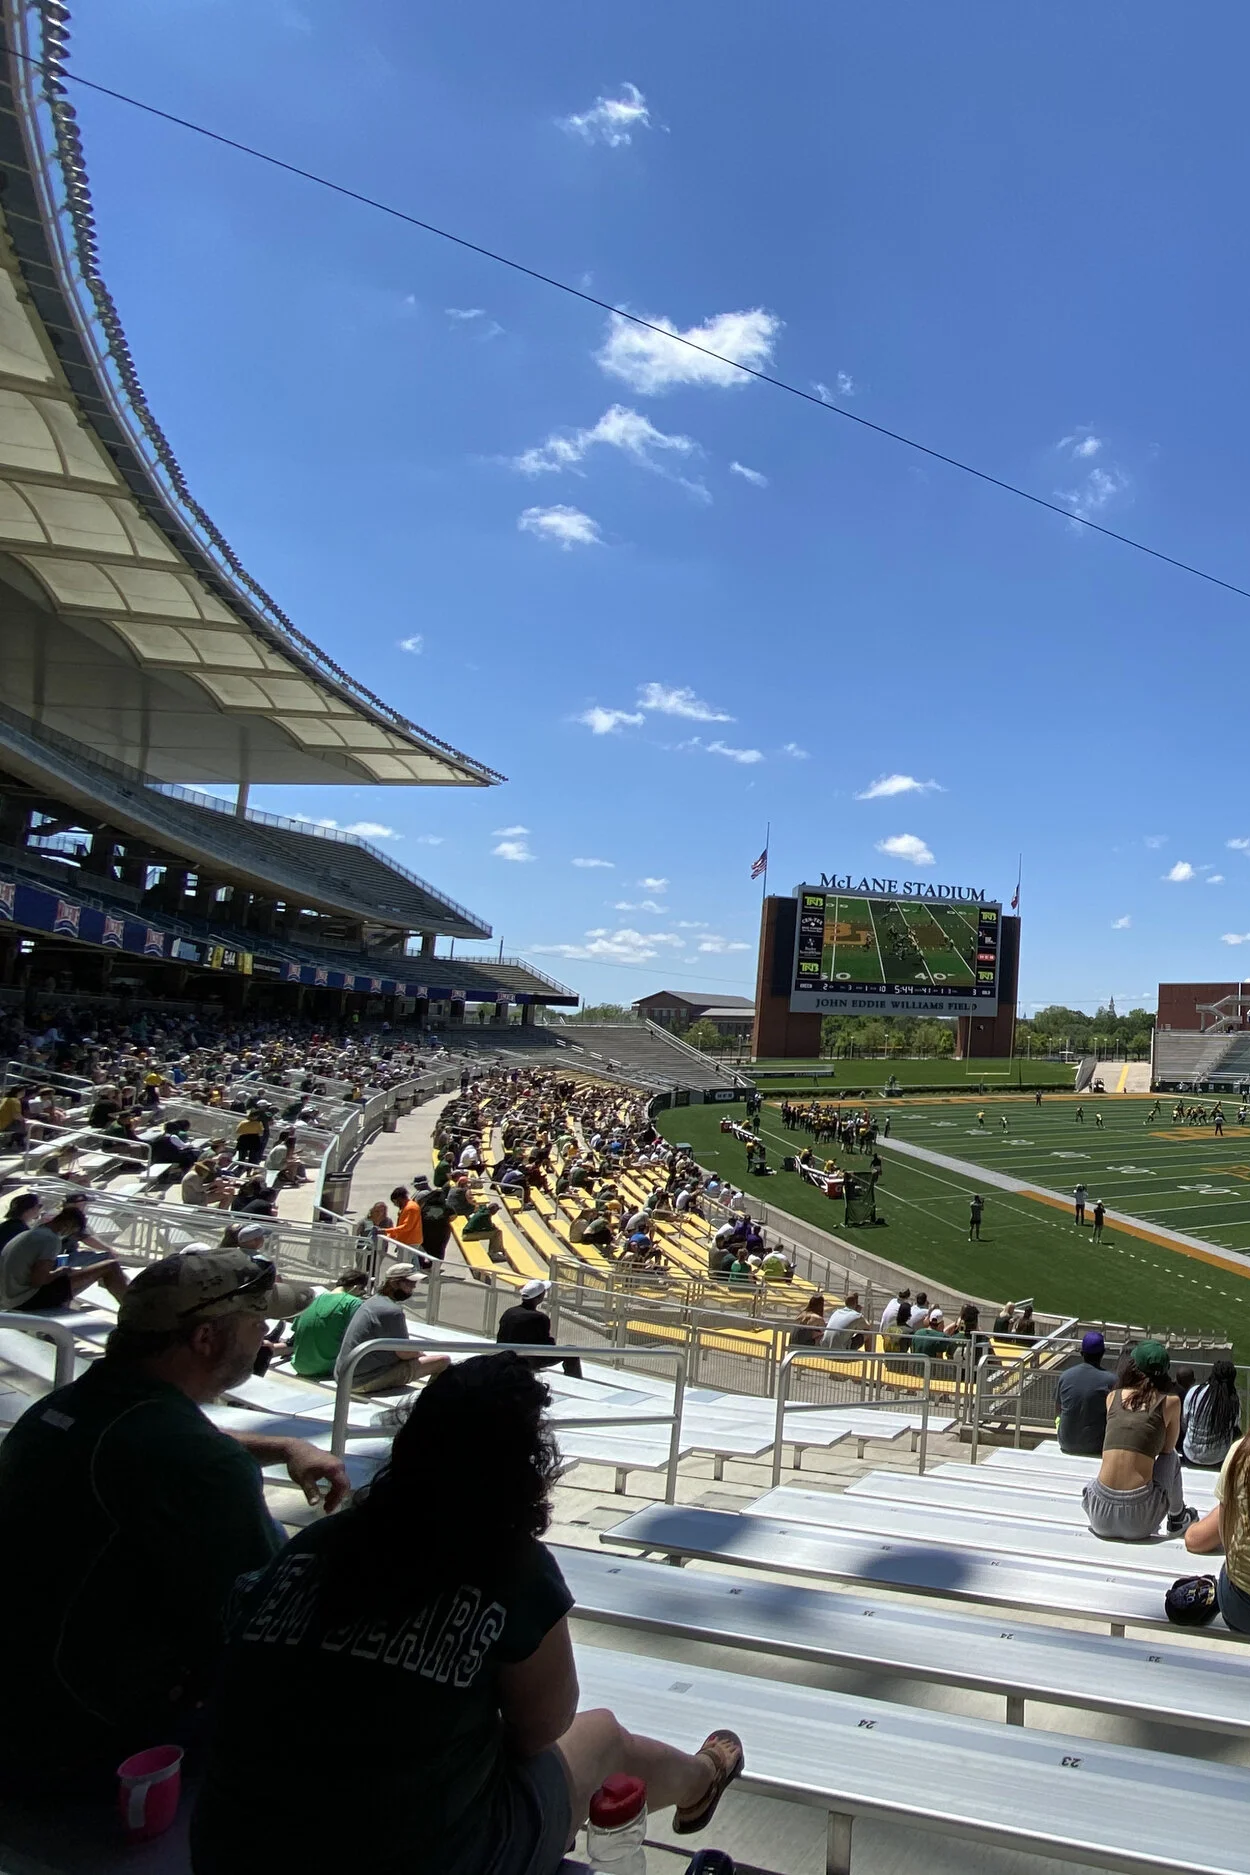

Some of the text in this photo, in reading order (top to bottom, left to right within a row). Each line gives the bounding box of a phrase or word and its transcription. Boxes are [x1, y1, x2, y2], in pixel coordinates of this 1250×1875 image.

[820, 872, 986, 901] McLANE STADIUM
[894, 984, 914, 994] 5:44
[815, 998, 978, 1011] JOHN EDDIE WILLIAMS FIELD
[999, 1632, 1014, 1640] 24
[1148, 1655, 1162, 1664] 23
[857, 1719, 877, 1729] 24
[1060, 1756, 1082, 1768] 23
